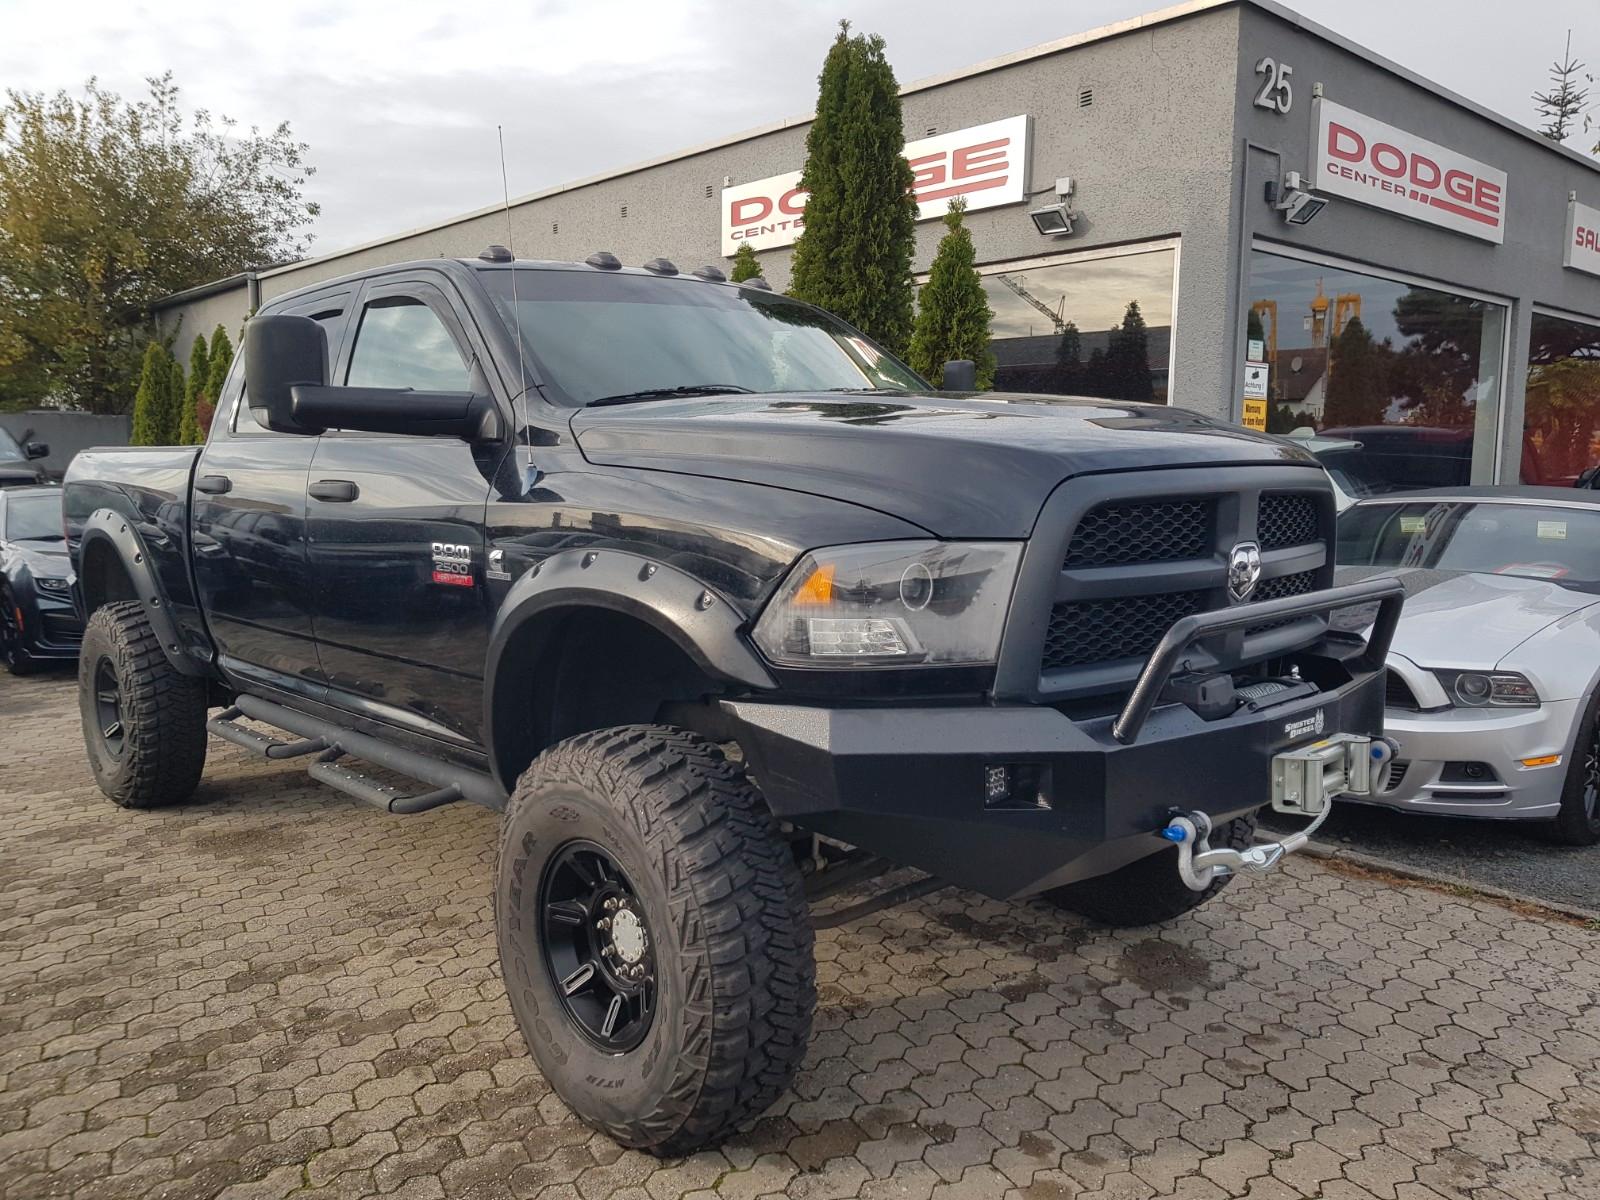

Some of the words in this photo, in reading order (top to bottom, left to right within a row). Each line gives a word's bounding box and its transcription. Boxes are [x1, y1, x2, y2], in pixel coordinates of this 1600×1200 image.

[1254, 57, 1293, 114] 25
[731, 137, 1010, 227] DOGE
[1327, 121, 1501, 213] DODGE
[1327, 163, 1406, 197] CENTER
[730, 217, 806, 240] CENTE
[435, 561, 468, 574] 2500
[1289, 725, 1314, 739] DIESEL
